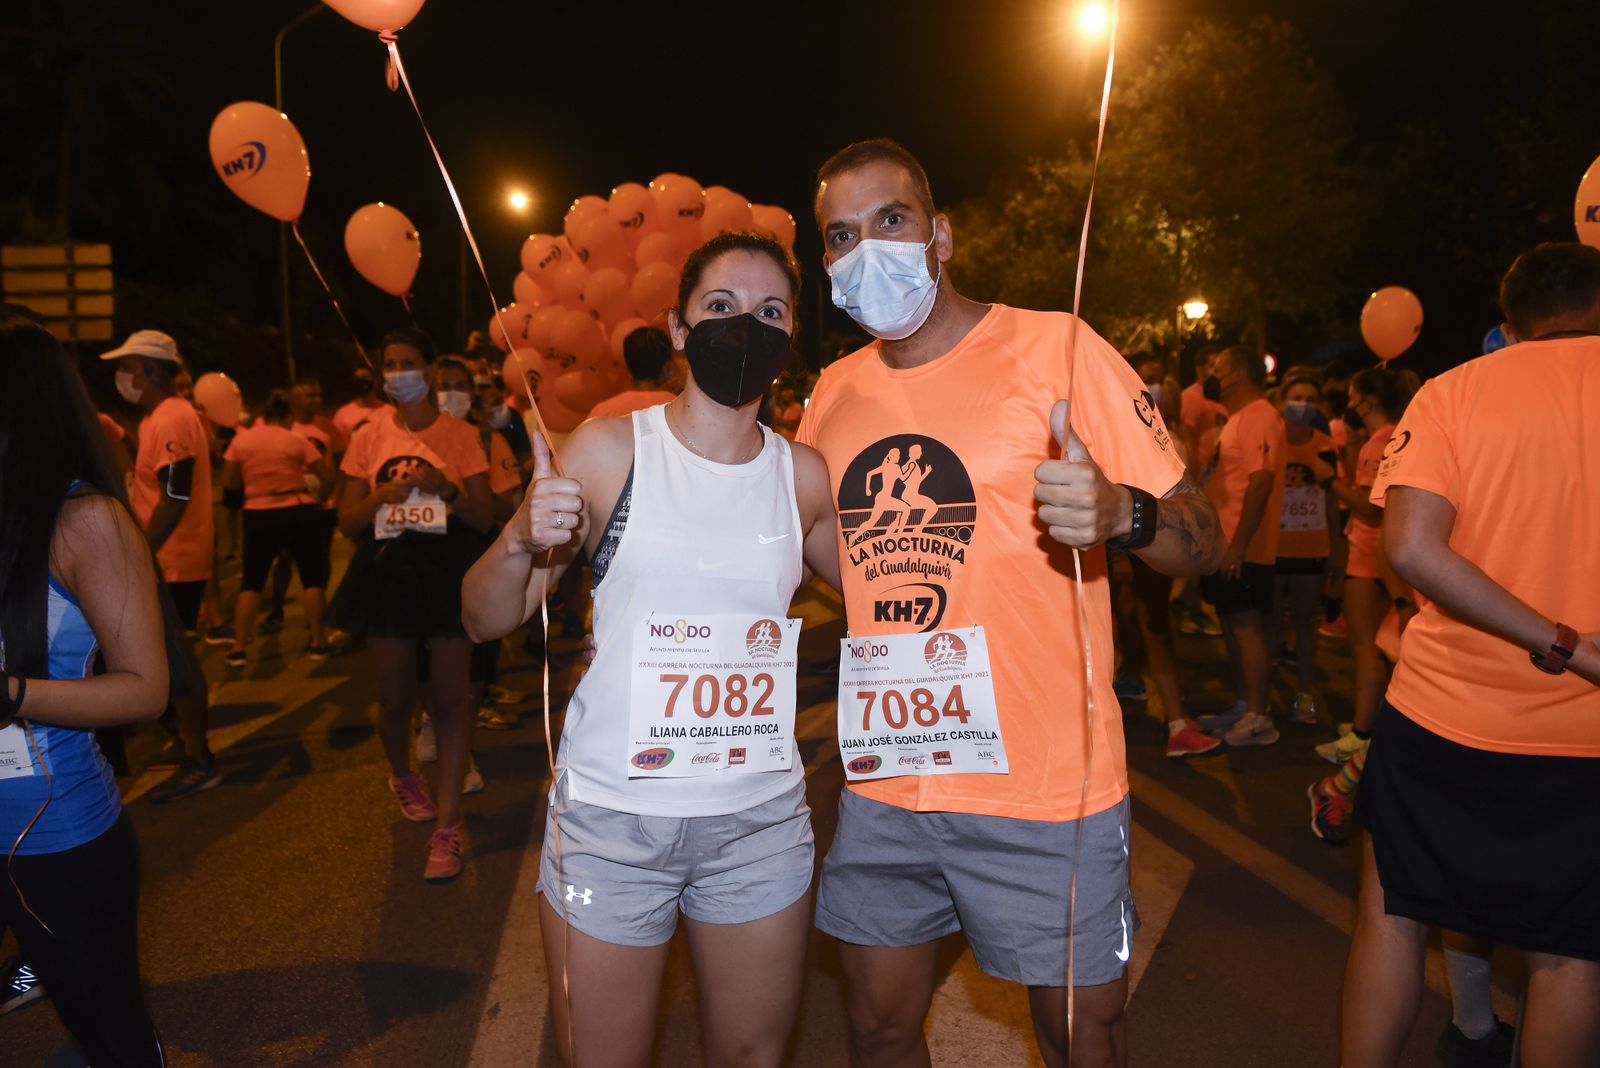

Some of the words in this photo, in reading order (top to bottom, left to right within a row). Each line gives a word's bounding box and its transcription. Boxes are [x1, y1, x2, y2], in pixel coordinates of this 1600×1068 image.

[386, 505, 434, 525] 4350
[849, 551, 870, 567] LA
[872, 537, 965, 565] NOCTURNA
[865, 565, 880, 581] del
[880, 557, 952, 580] Guadalquivir
[734, 661, 772, 669] GUADALQUIVIR
[916, 675, 960, 684] GUADALQUIVIR
[660, 673, 775, 718] 7082
[857, 684, 971, 731] 7084
[650, 727, 687, 738] ILIANA
[690, 724, 752, 738] CABALLERO
[754, 723, 779, 735] ROCA
[842, 738, 865, 749] JUAN
[868, 734, 893, 747] JOSÉ
[895, 732, 948, 745] GONZÁLEZ
[950, 730, 999, 740] CASTILLA
[769, 746, 784, 754] ABC
